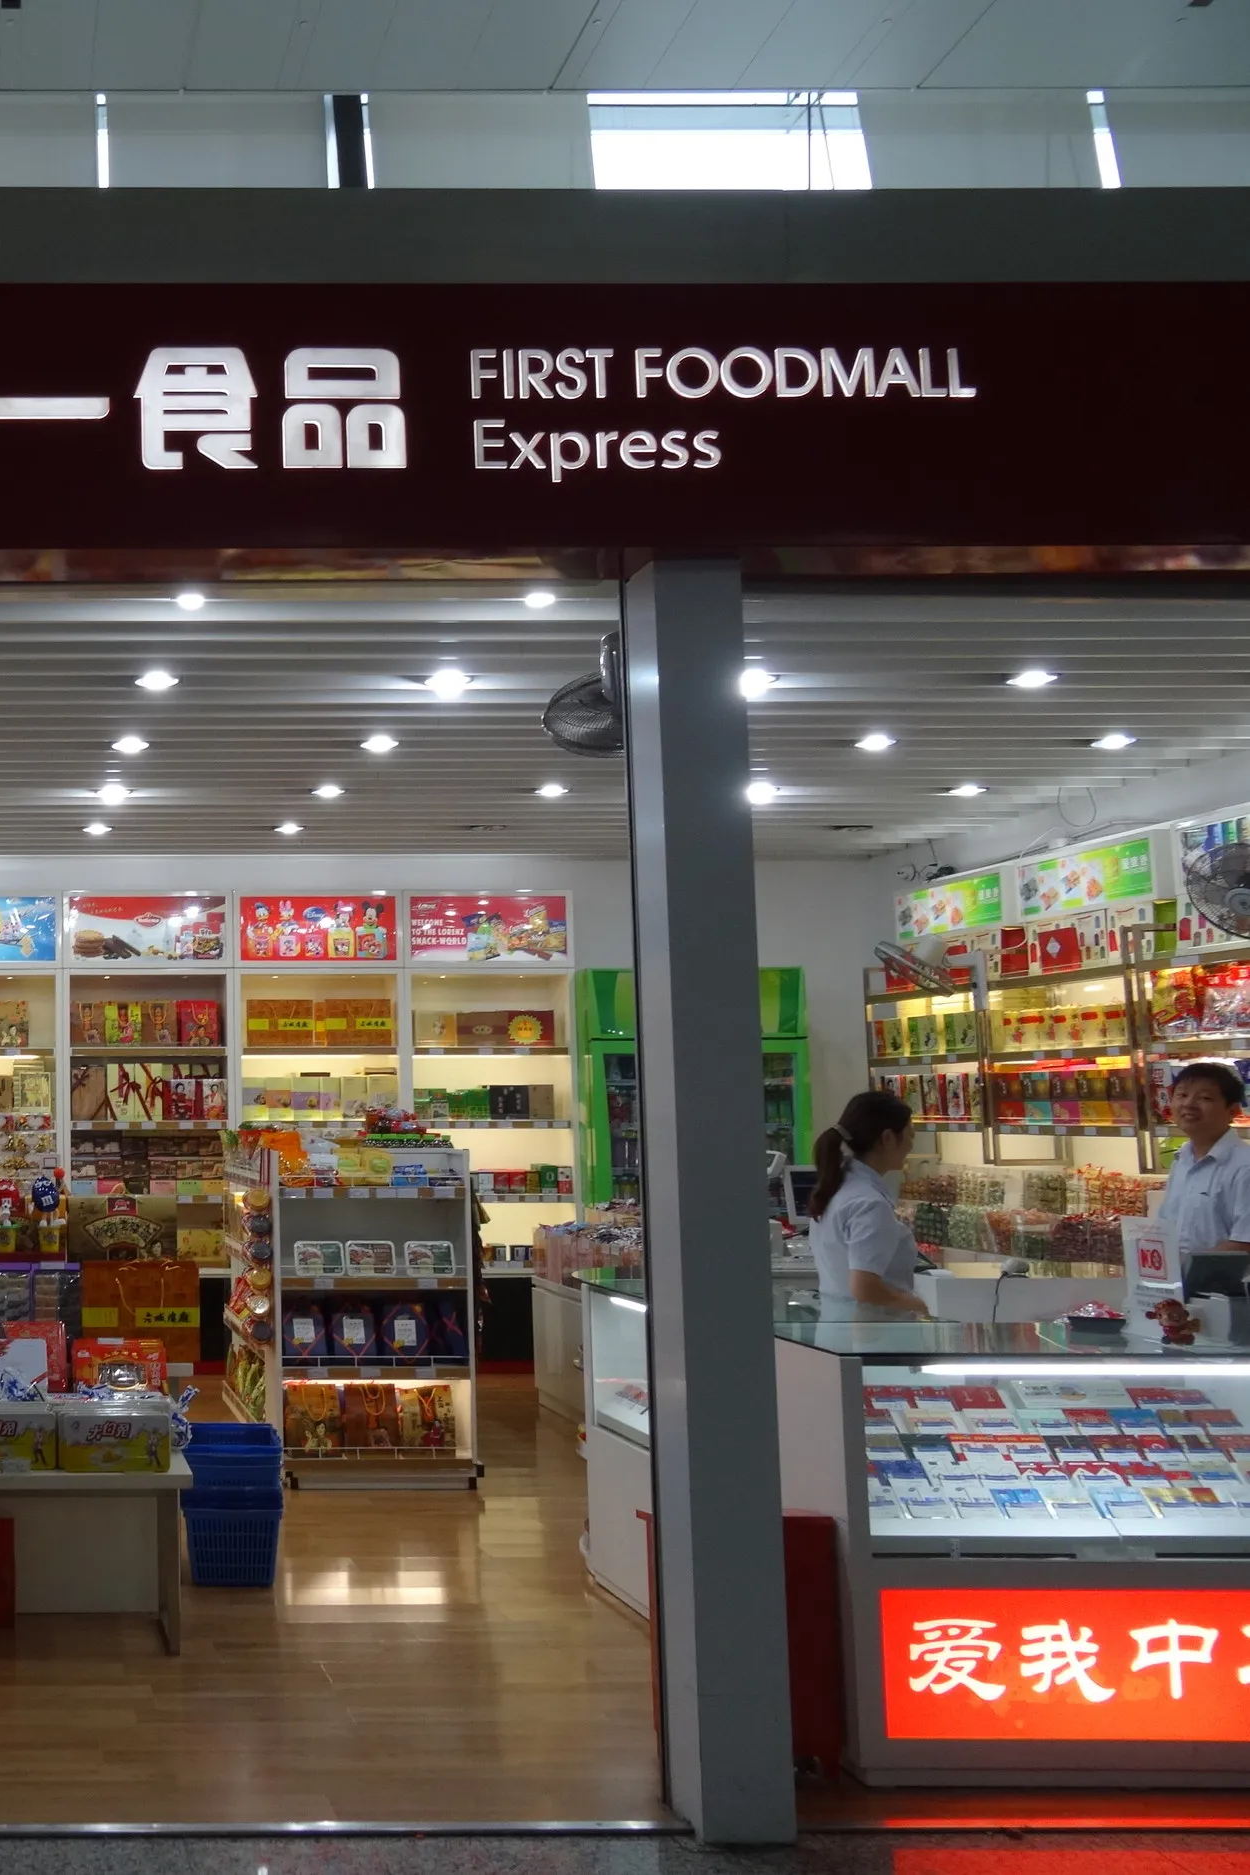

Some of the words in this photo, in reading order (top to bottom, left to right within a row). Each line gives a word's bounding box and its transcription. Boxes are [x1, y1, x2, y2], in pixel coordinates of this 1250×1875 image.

[471, 348, 613, 399] FIRST
[635, 347, 976, 398] FOODMALL
[474, 420, 721, 482] Express
[411, 937, 467, 945] SNACK-WORLD
[908, 1618, 1250, 1703] 爱我中
